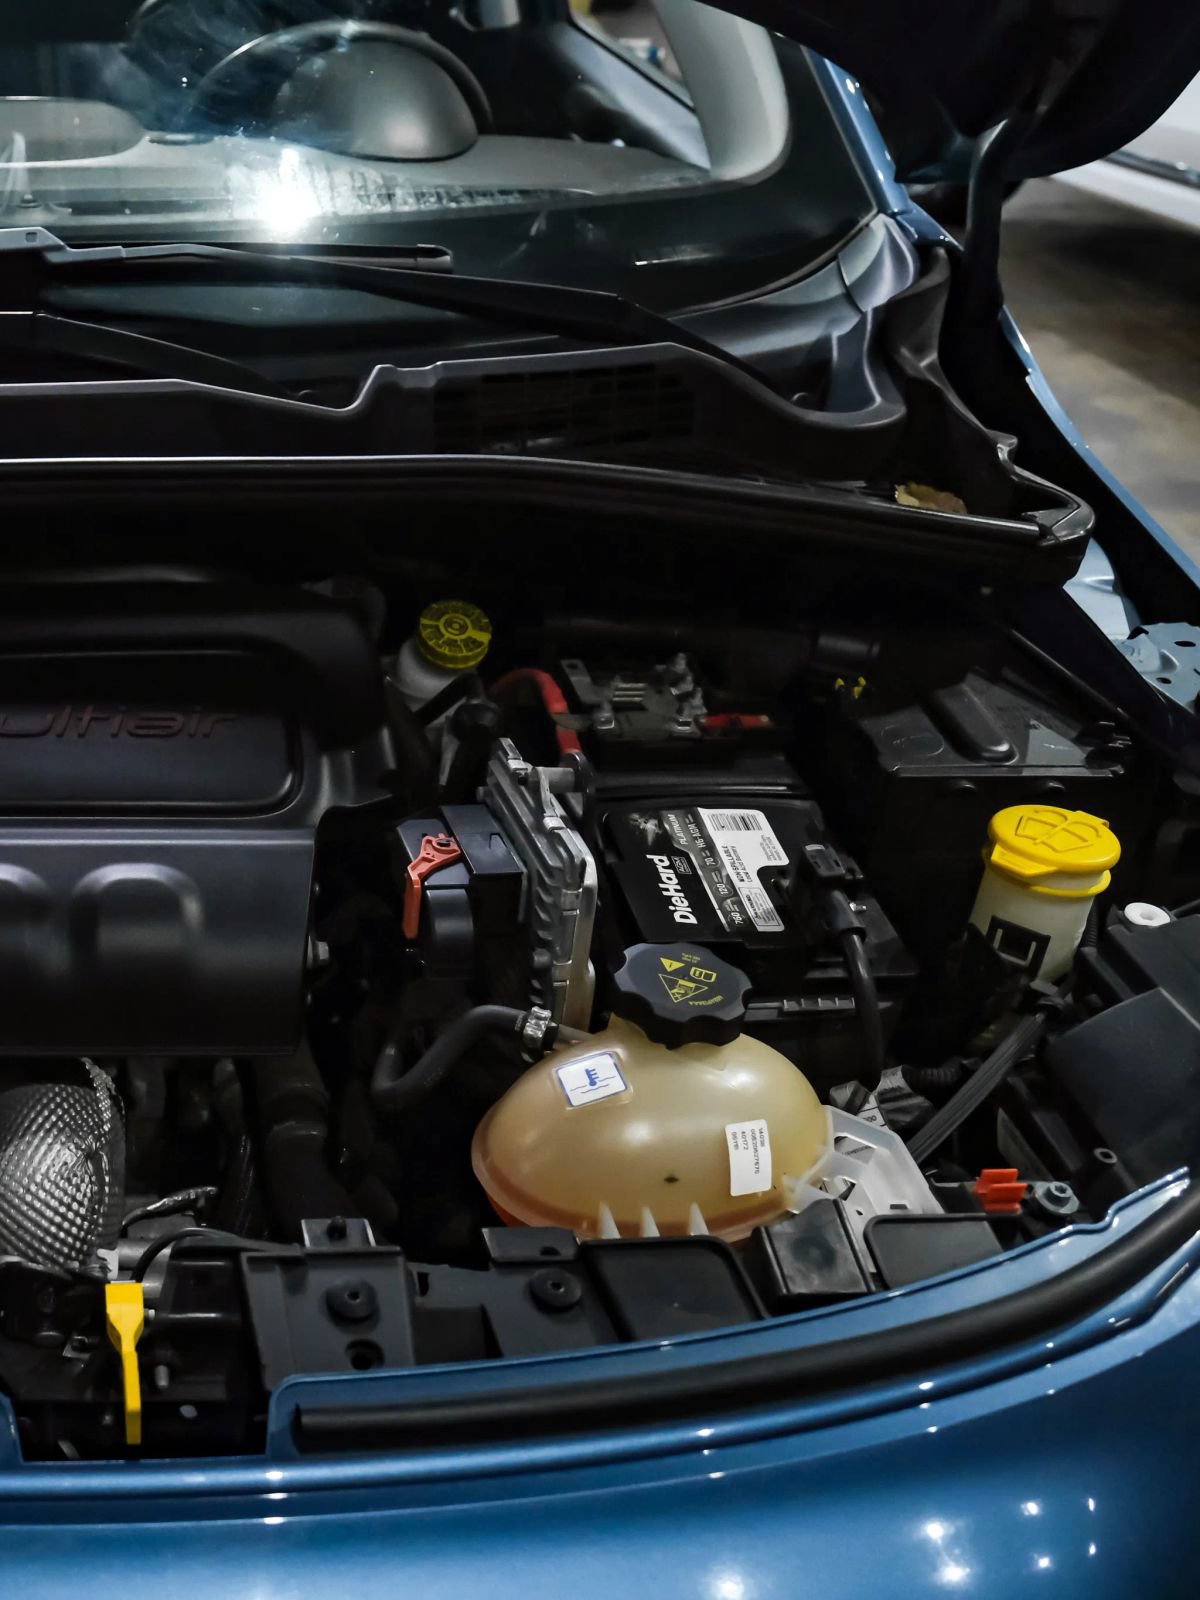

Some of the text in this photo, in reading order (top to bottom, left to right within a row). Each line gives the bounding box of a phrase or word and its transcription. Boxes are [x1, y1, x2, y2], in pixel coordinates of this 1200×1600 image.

[667, 813, 689, 846] PLATINUM
[704, 857, 716, 866] 70
[646, 854, 698, 925] DieHard
[716, 883, 729, 895] 120
[731, 911, 744, 925] 760
